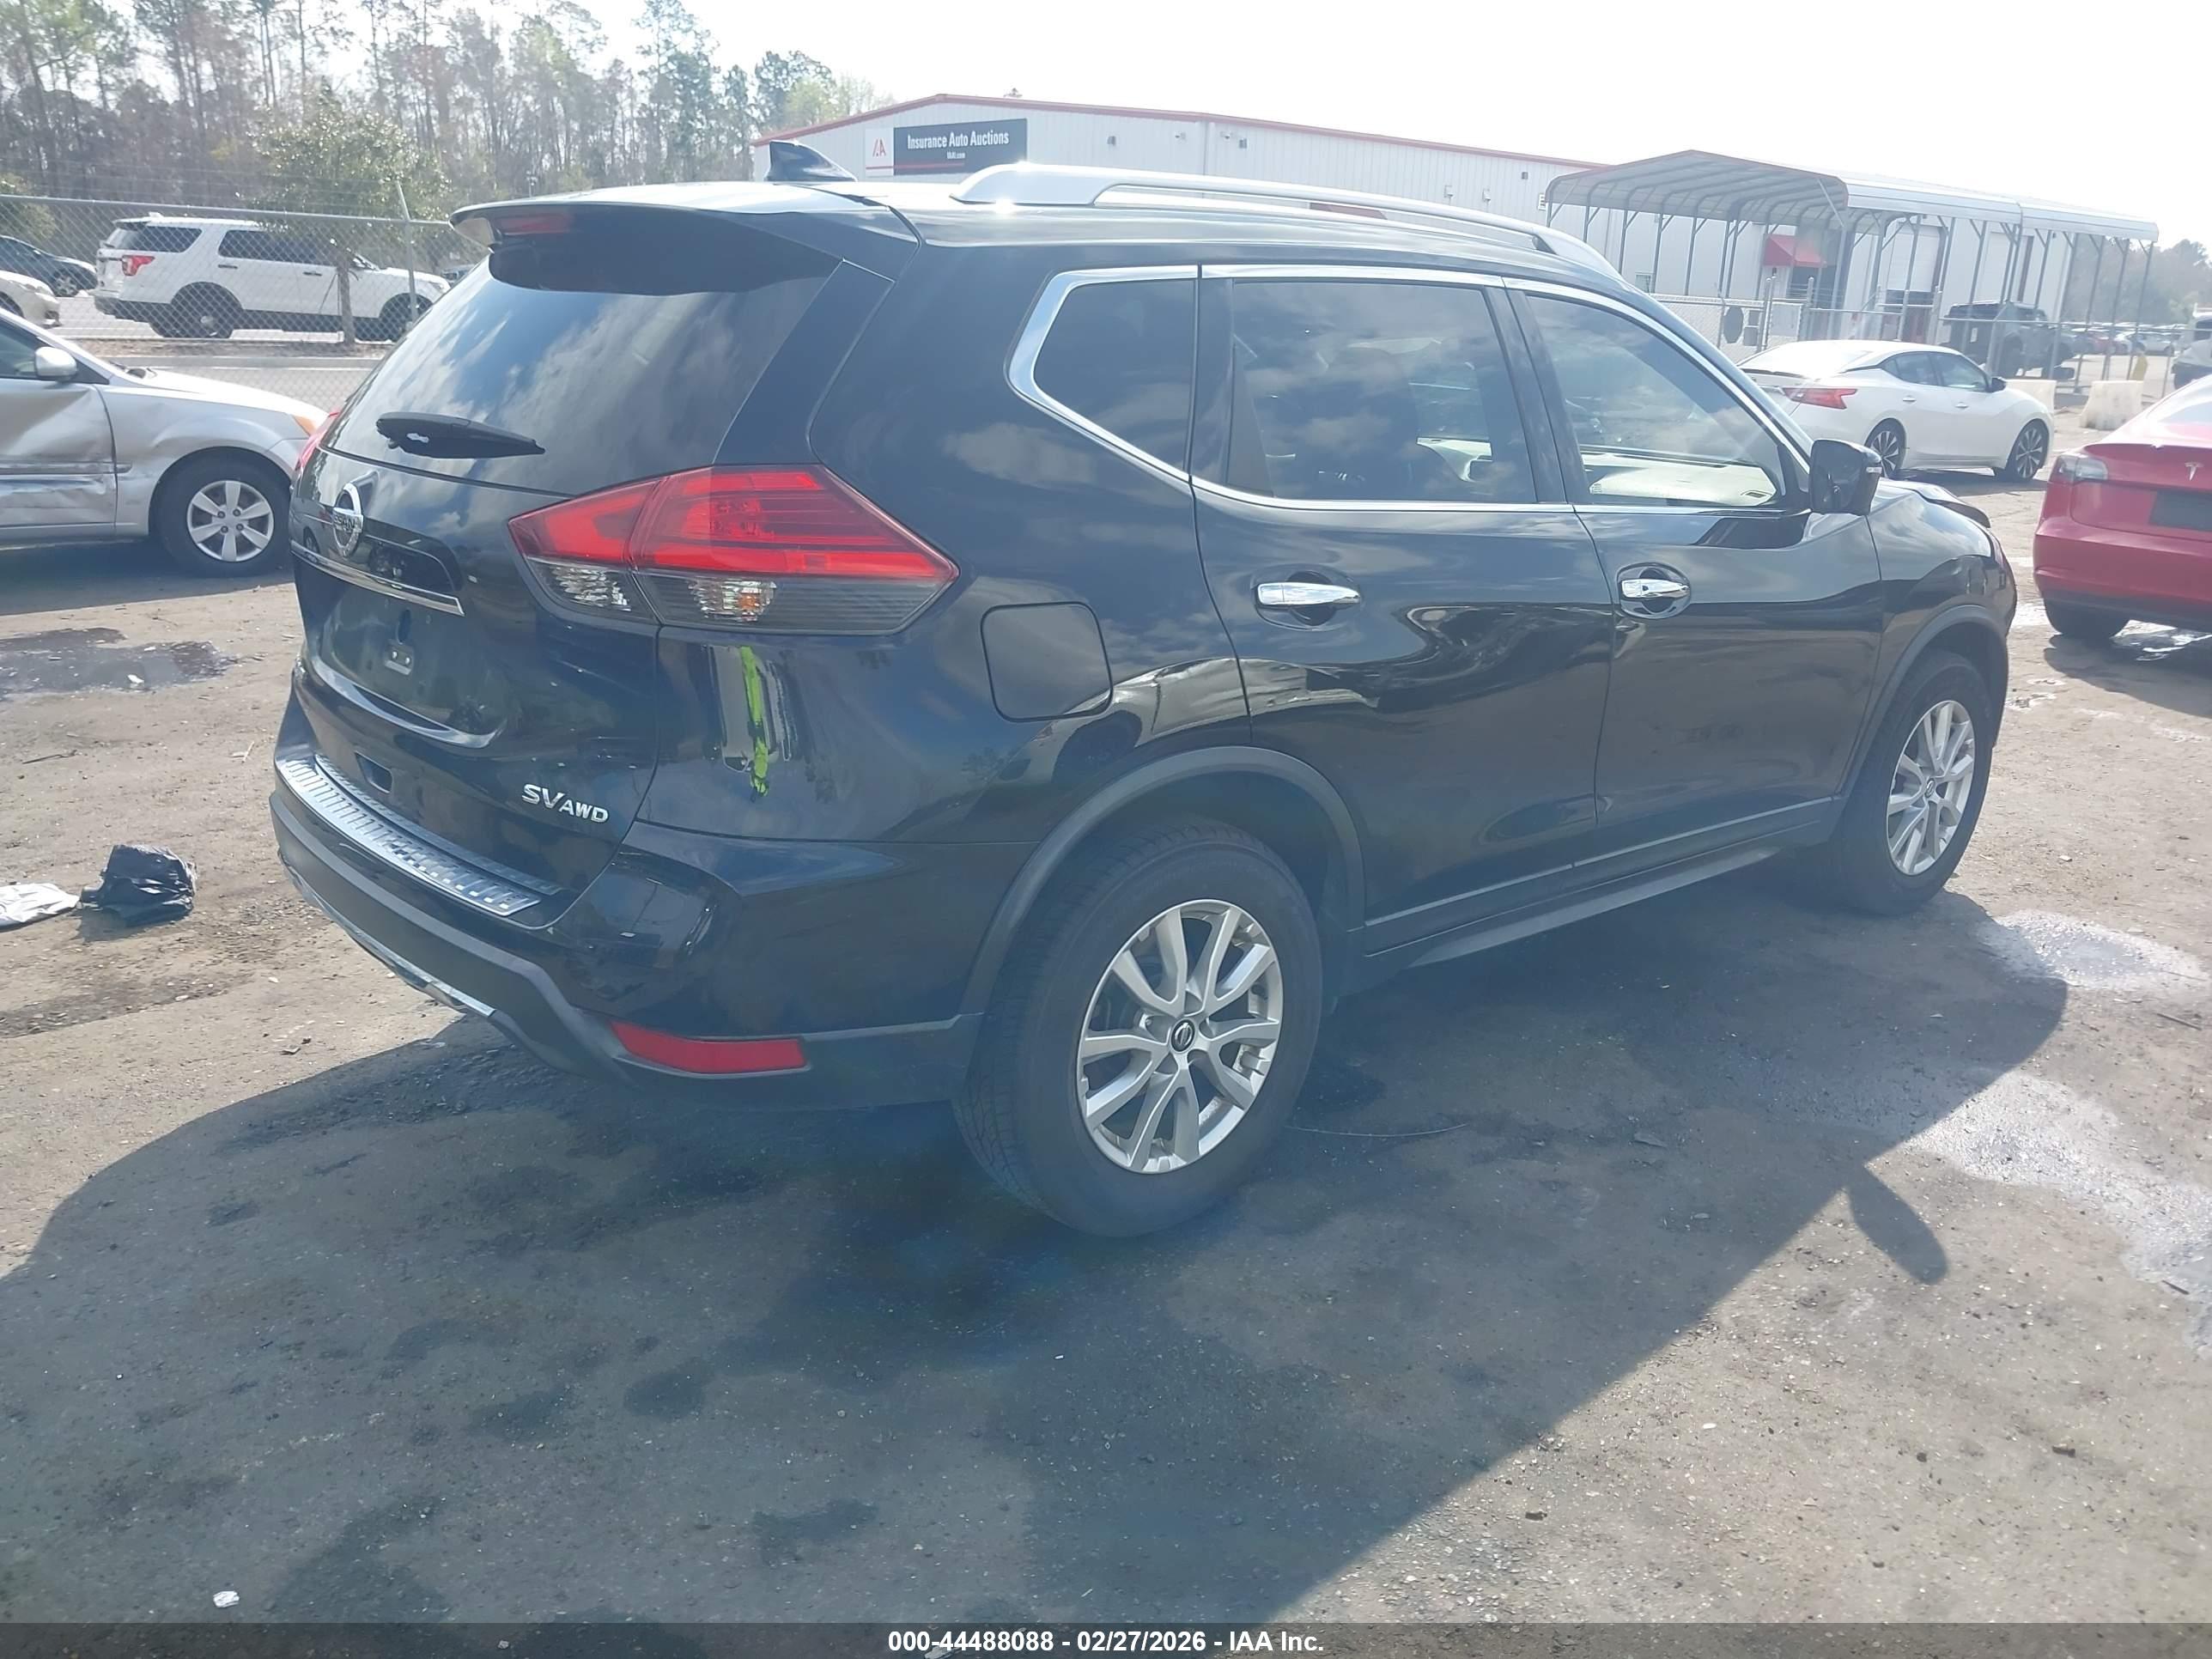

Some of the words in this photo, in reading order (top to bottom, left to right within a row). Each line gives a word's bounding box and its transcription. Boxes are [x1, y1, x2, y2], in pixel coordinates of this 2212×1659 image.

[908, 135, 947, 149] Insurance
[949, 131, 969, 148] Auto
[969, 130, 1010, 146] Auctions
[521, 783, 565, 809] SV
[558, 799, 609, 823] AWD
